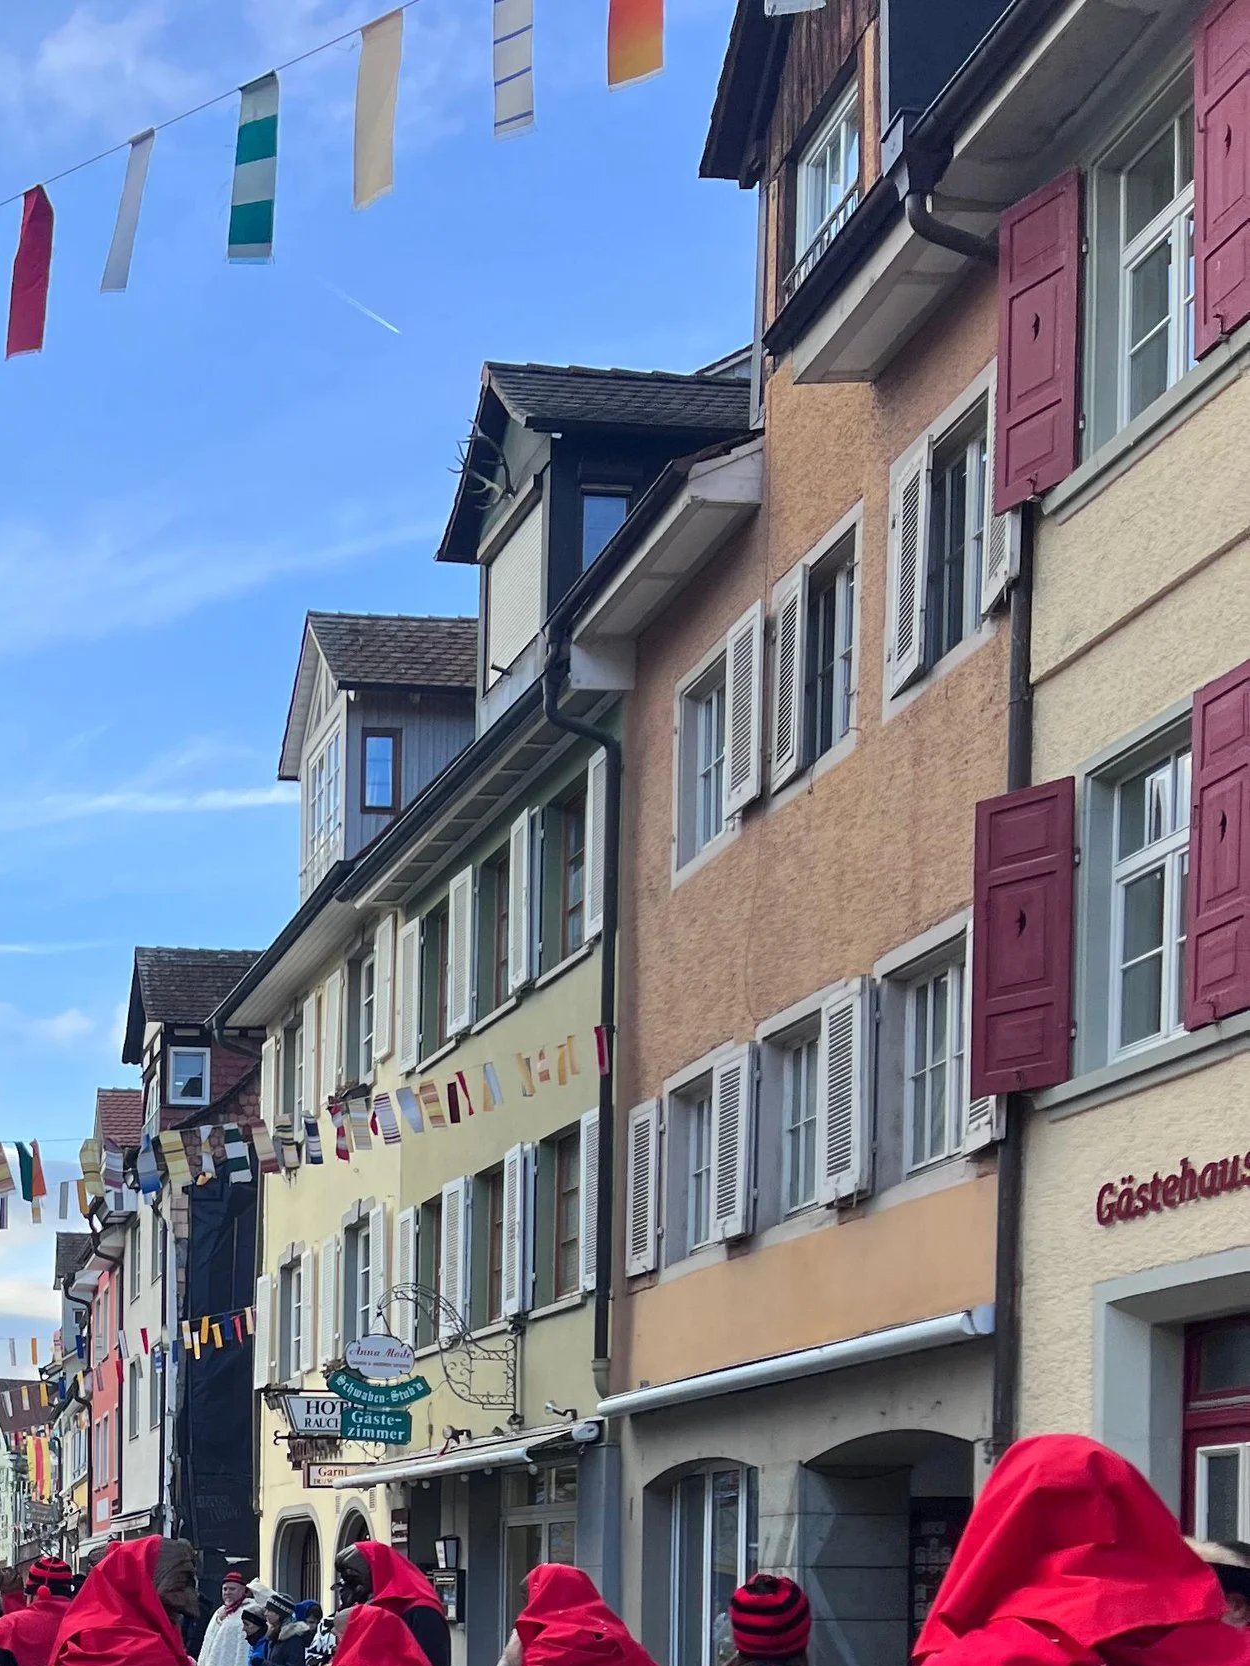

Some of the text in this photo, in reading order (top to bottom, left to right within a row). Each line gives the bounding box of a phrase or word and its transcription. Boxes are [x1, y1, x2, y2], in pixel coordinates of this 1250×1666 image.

[351, 1410, 402, 1426] Gäste-
[347, 1425, 405, 1441] zimmer
[318, 1466, 349, 1477] Garni
